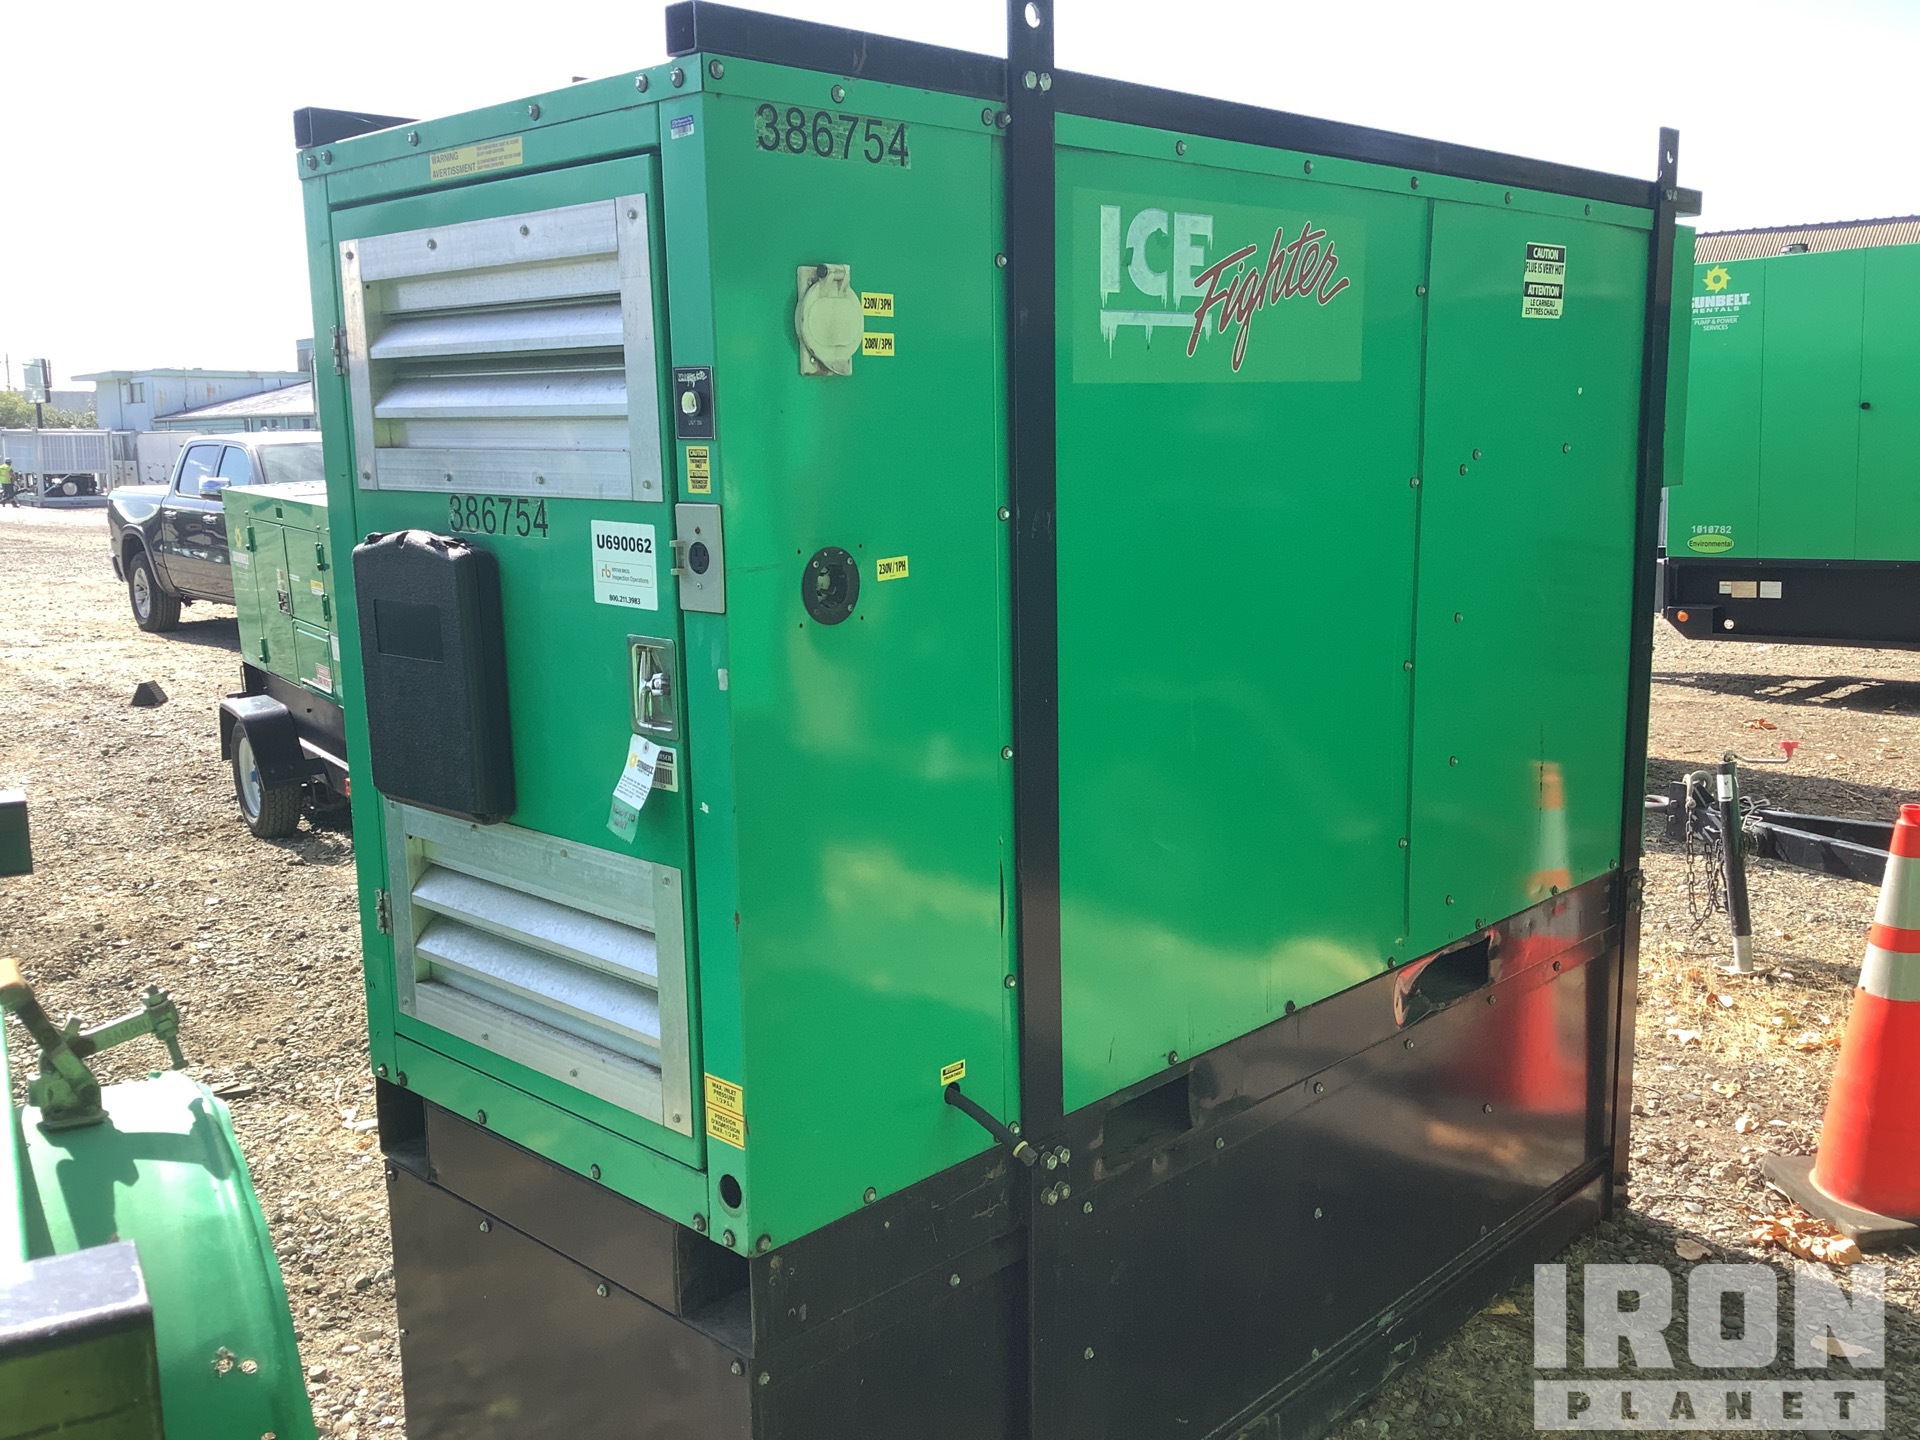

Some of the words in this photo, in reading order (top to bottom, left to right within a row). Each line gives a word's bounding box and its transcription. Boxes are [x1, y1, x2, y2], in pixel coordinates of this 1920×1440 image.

[757, 103, 908, 167] 386754
[431, 152, 459, 165] WARNING
[1100, 204, 1213, 311] ICE
[1533, 247, 1559, 260] CAUTION
[1526, 261, 1537, 273] FLUE
[1538, 263, 1543, 273] IS
[1543, 263, 1554, 275] VERY
[1555, 264, 1564, 275] HOT
[1187, 220, 1350, 373] Fighter
[1527, 284, 1560, 297] ATTENTION
[863, 297, 892, 311] 230V/3PH
[1530, 298, 1536, 306] LE
[1525, 307, 1533, 315] EST
[1692, 306, 1740, 314] RENTALS
[1703, 324, 1729, 332] SERVICES
[864, 337, 893, 350] 208V/3PH
[450, 495, 548, 538] 386754
[1691, 525, 1732, 534] 1010782
[596, 534, 652, 554] U690062
[601, 564, 611, 578] rb
[879, 560, 906, 575] 230V/1PH
[630, 576, 649, 584] Operations
[609, 594, 641, 605] 800.211.3983
[712, 1082, 723, 1092] MAX.
[724, 1087, 737, 1097] INLET
[713, 1089, 736, 1103] PRESSURE
[714, 1113, 736, 1127] PRESSION
[713, 1124, 724, 1134] MAX.
